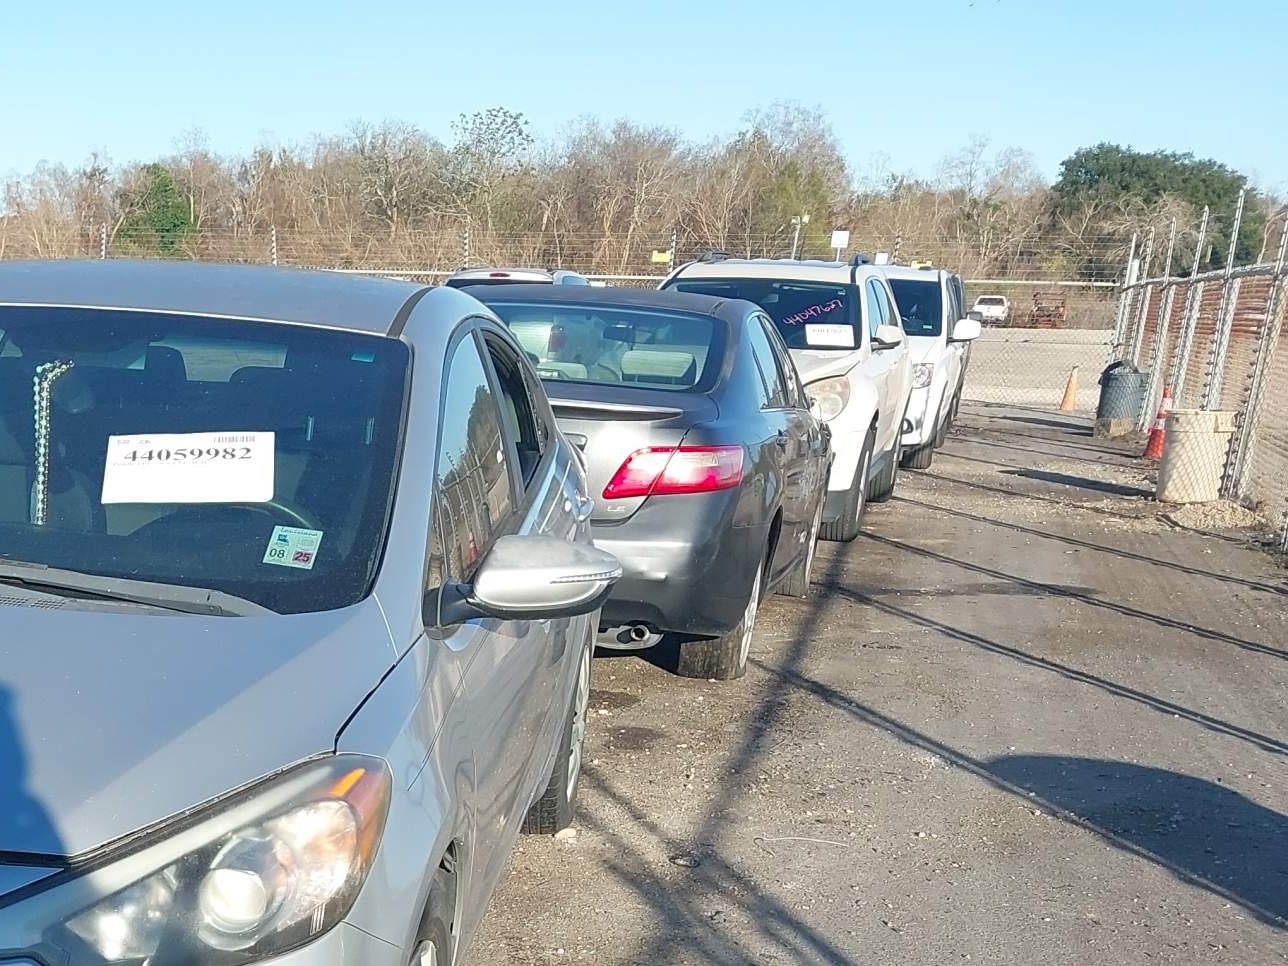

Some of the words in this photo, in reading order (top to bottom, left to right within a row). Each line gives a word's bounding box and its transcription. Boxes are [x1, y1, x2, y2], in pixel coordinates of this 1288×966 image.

[123, 447, 252, 462] 44059982
[269, 548, 285, 558] 08
[294, 551, 312, 562] 25
